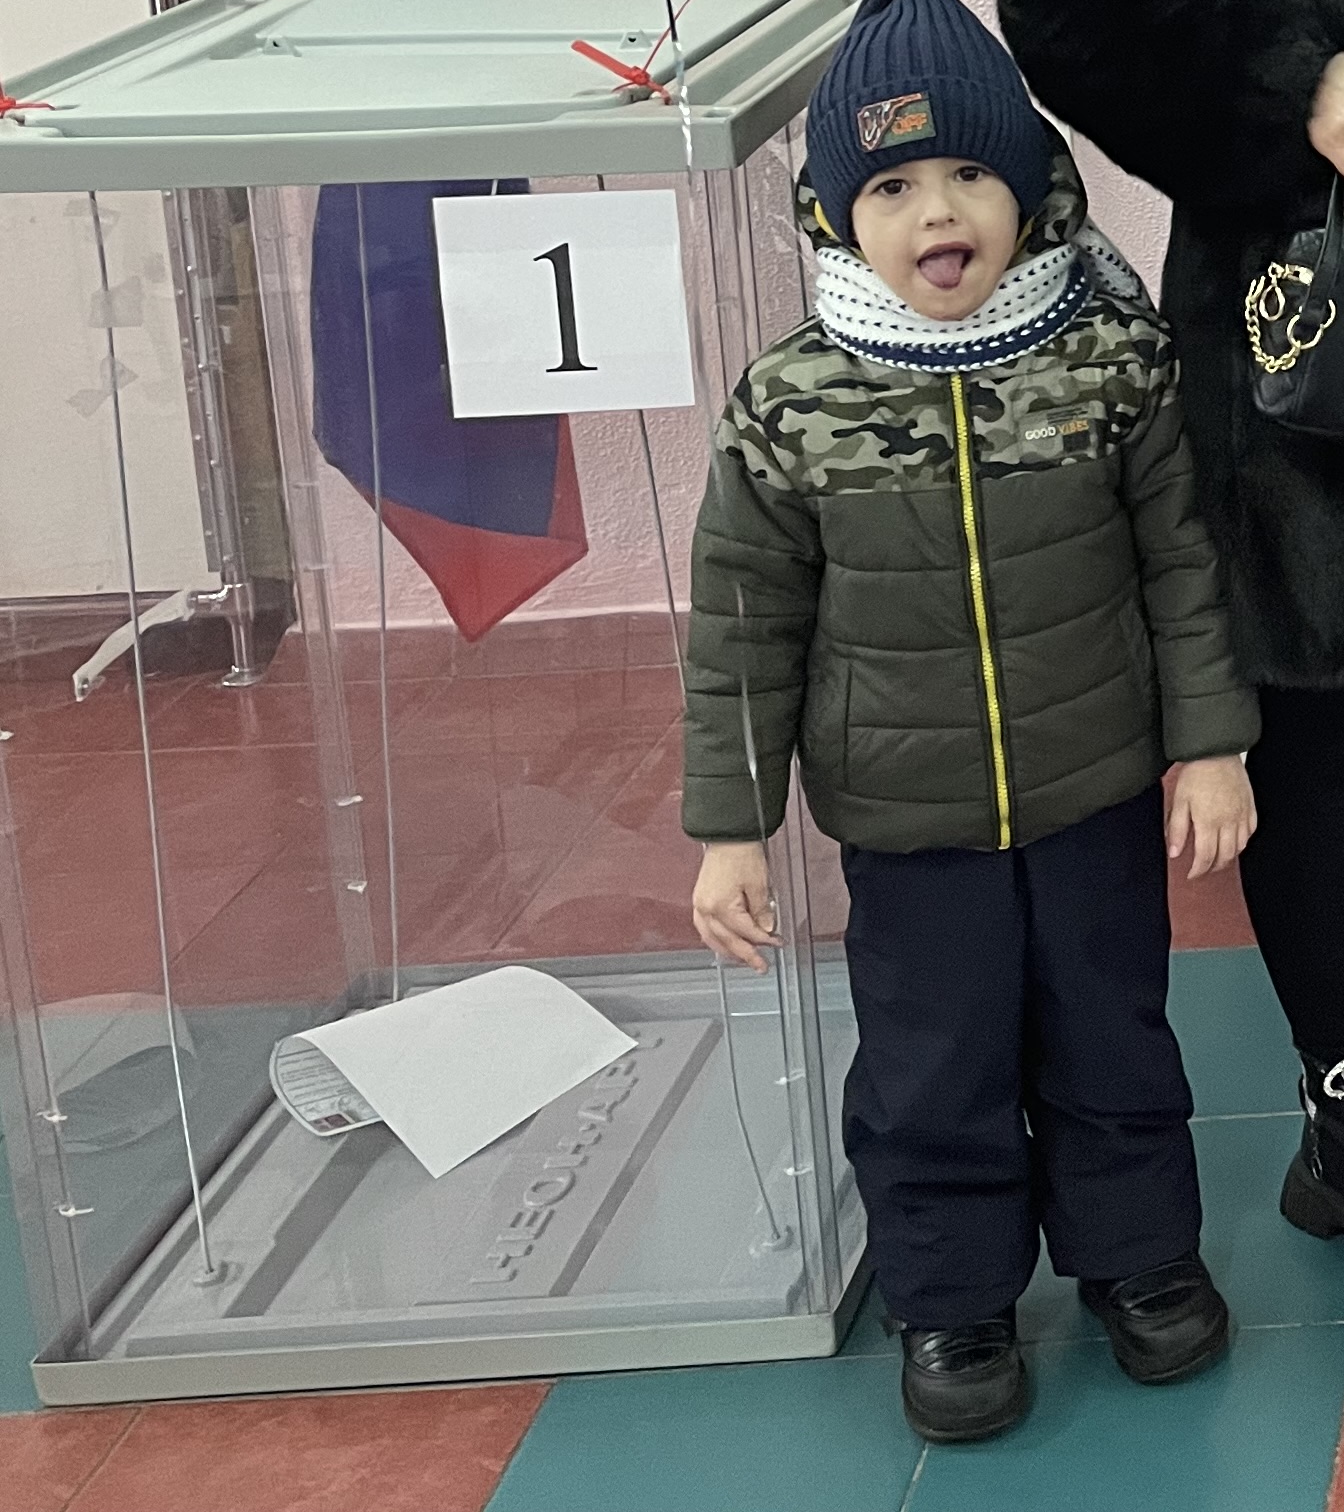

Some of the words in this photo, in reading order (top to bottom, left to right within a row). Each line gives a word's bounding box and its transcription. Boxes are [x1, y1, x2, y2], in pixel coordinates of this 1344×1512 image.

[533, 242, 598, 374] 1
[1025, 426, 1056, 440] GOOD
[1057, 420, 1089, 435] VIBES
